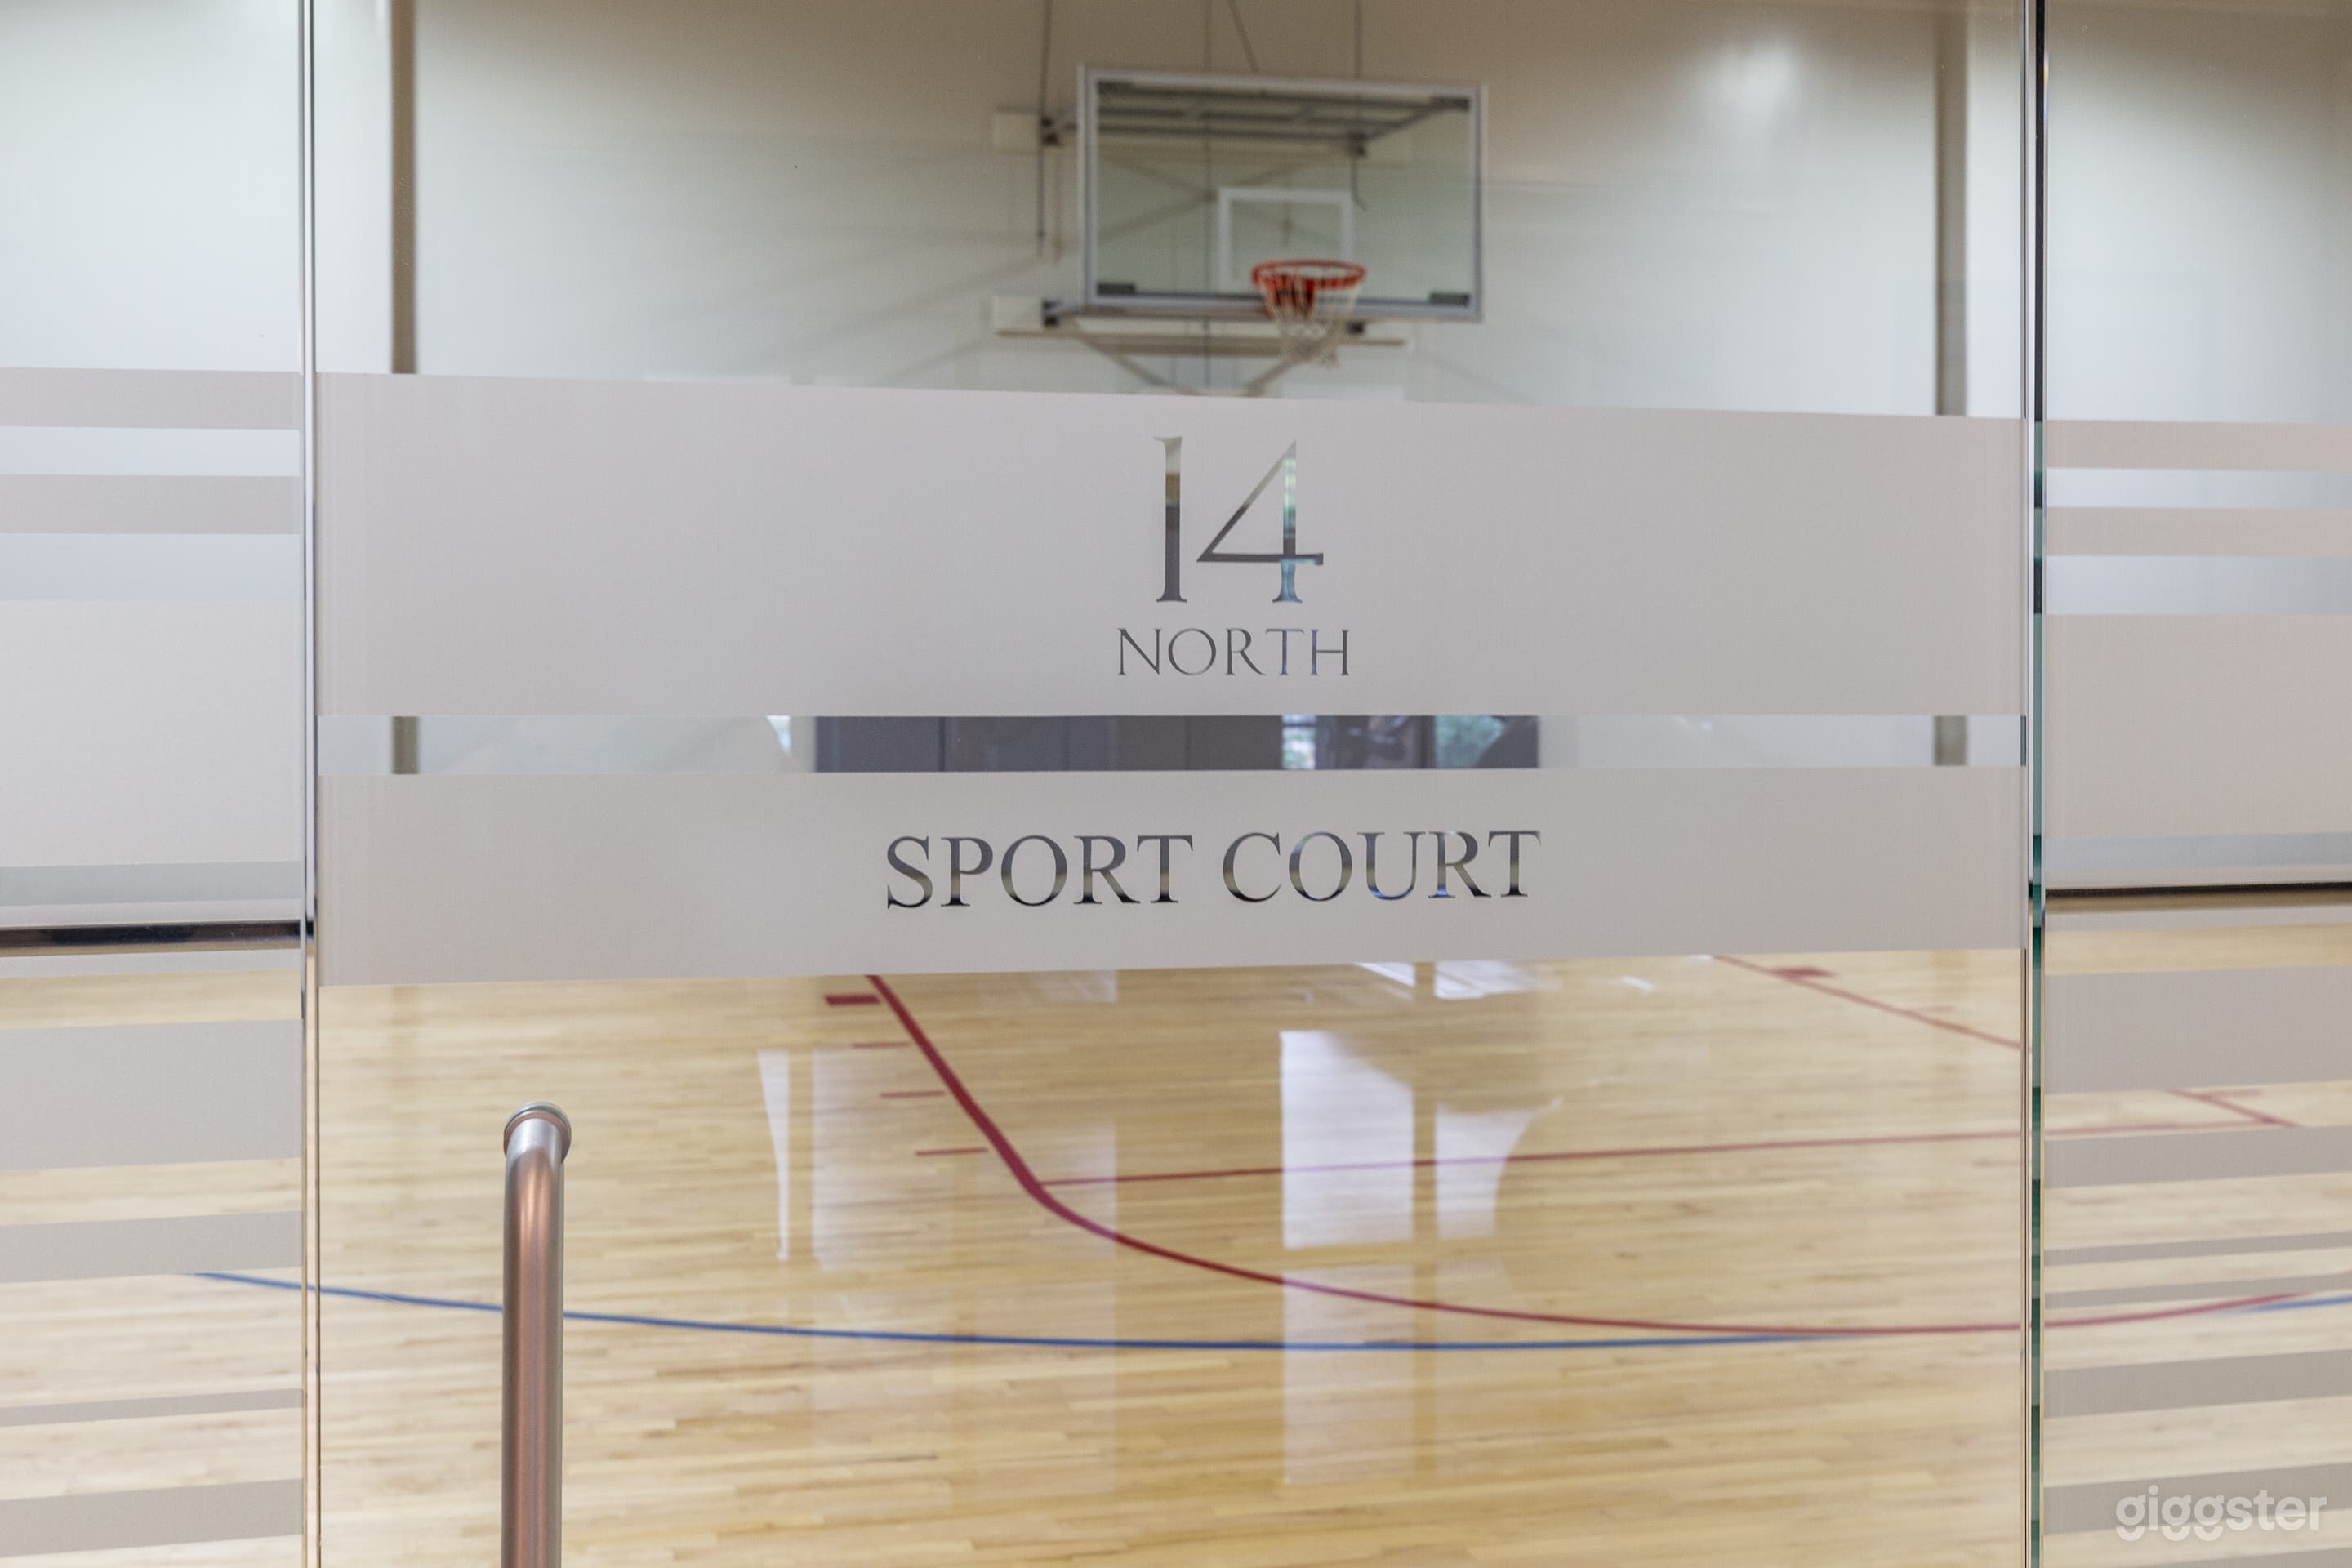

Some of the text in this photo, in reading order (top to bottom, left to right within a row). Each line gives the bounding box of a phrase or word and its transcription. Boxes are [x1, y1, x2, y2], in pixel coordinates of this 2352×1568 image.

[1153, 436, 1325, 604] 14
[1117, 627, 1351, 677] NORTH
[886, 830, 1542, 909] SPORT COURT
